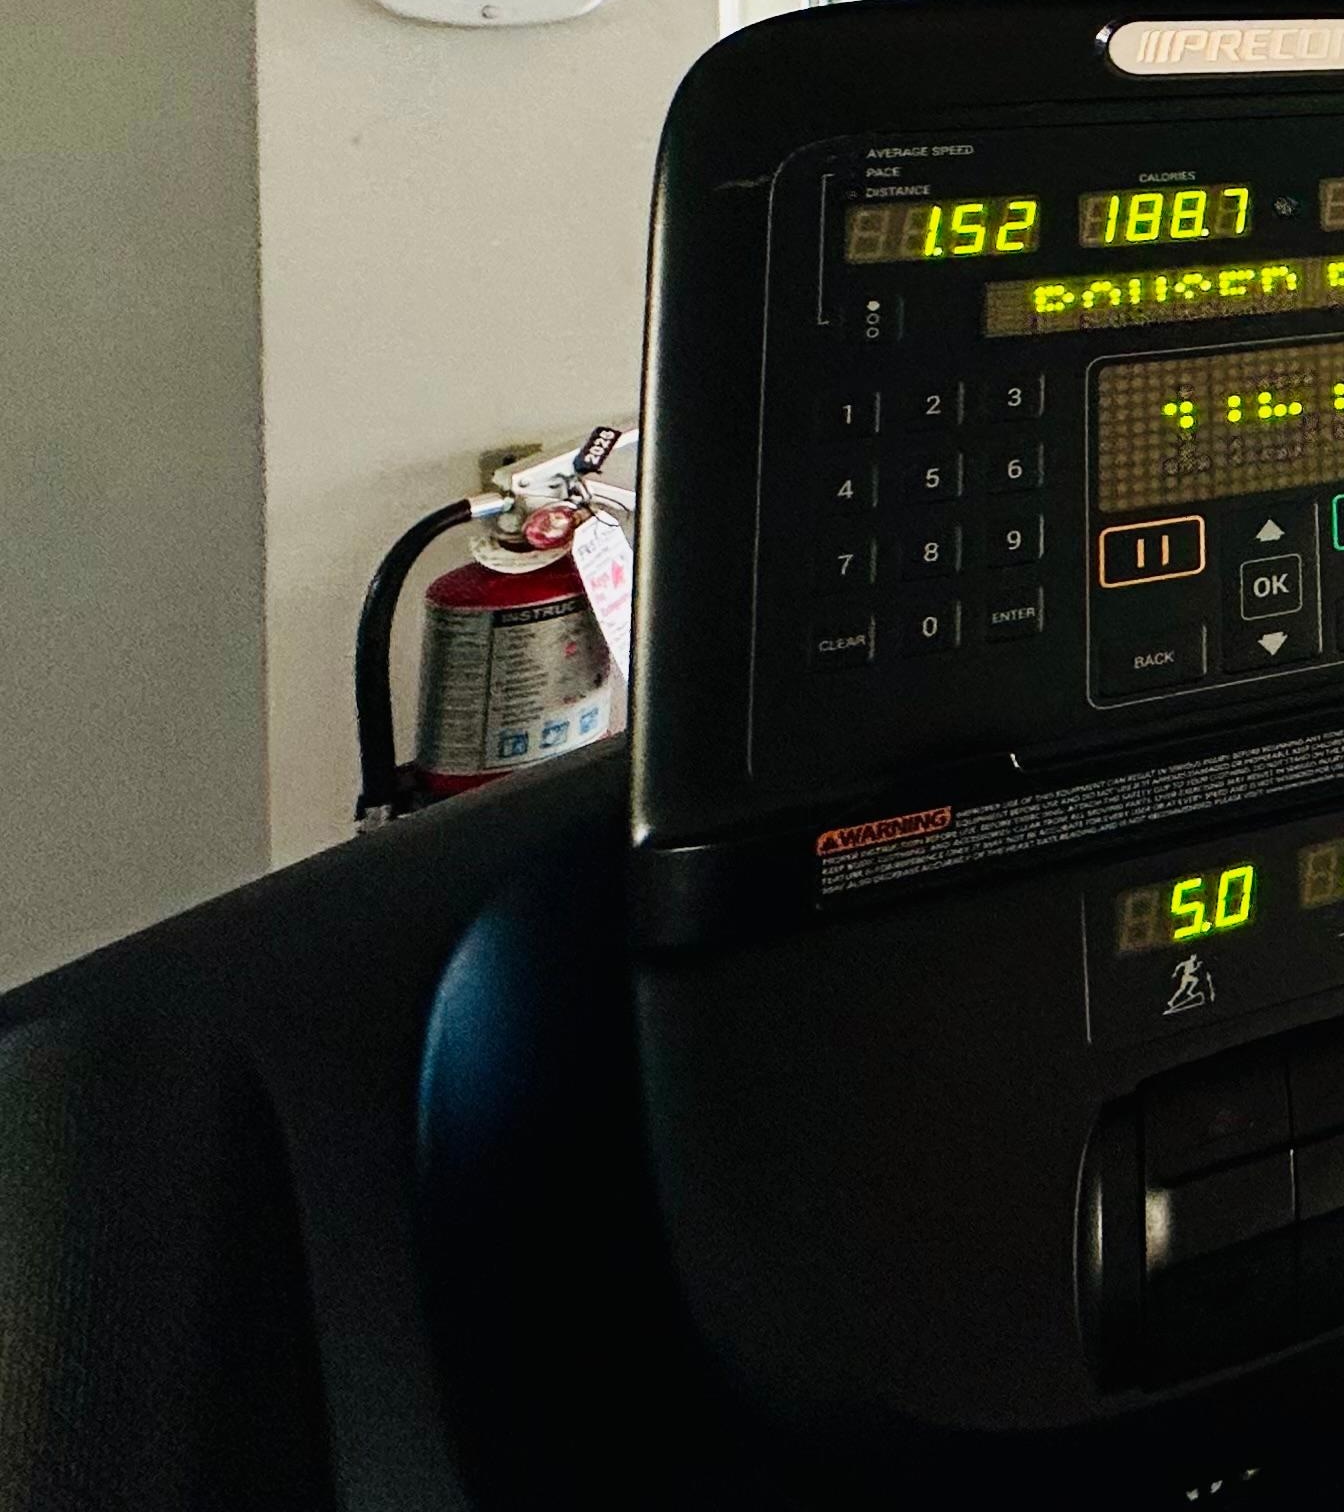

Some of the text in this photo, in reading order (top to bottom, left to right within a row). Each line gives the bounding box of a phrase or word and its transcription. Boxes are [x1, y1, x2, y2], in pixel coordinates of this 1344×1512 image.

[866, 144, 975, 159] AVERAGE SPEED
[866, 166, 902, 178] PACE
[1138, 170, 1197, 183] CALORIES
[866, 184, 932, 198] DISTANCE
[1104, 187, 1249, 243] 188.7
[923, 199, 1038, 257] 1.52
[925, 395, 941, 415] 2
[1007, 388, 1022, 407] 3
[842, 404, 852, 424] 1
[925, 468, 940, 488] 5
[1007, 459, 1023, 478] 6
[837, 480, 854, 499] 4
[1007, 530, 1021, 550] 9
[923, 542, 939, 562] 8
[837, 554, 854, 575] 7
[1252, 573, 1290, 599] OK
[992, 607, 1036, 624] ENTER
[922, 616, 938, 637] 0
[818, 634, 866, 652] CLEAR
[1134, 650, 1175, 669] BACK
[838, 810, 947, 846] WARNING
[1170, 865, 1254, 939] 5.0
